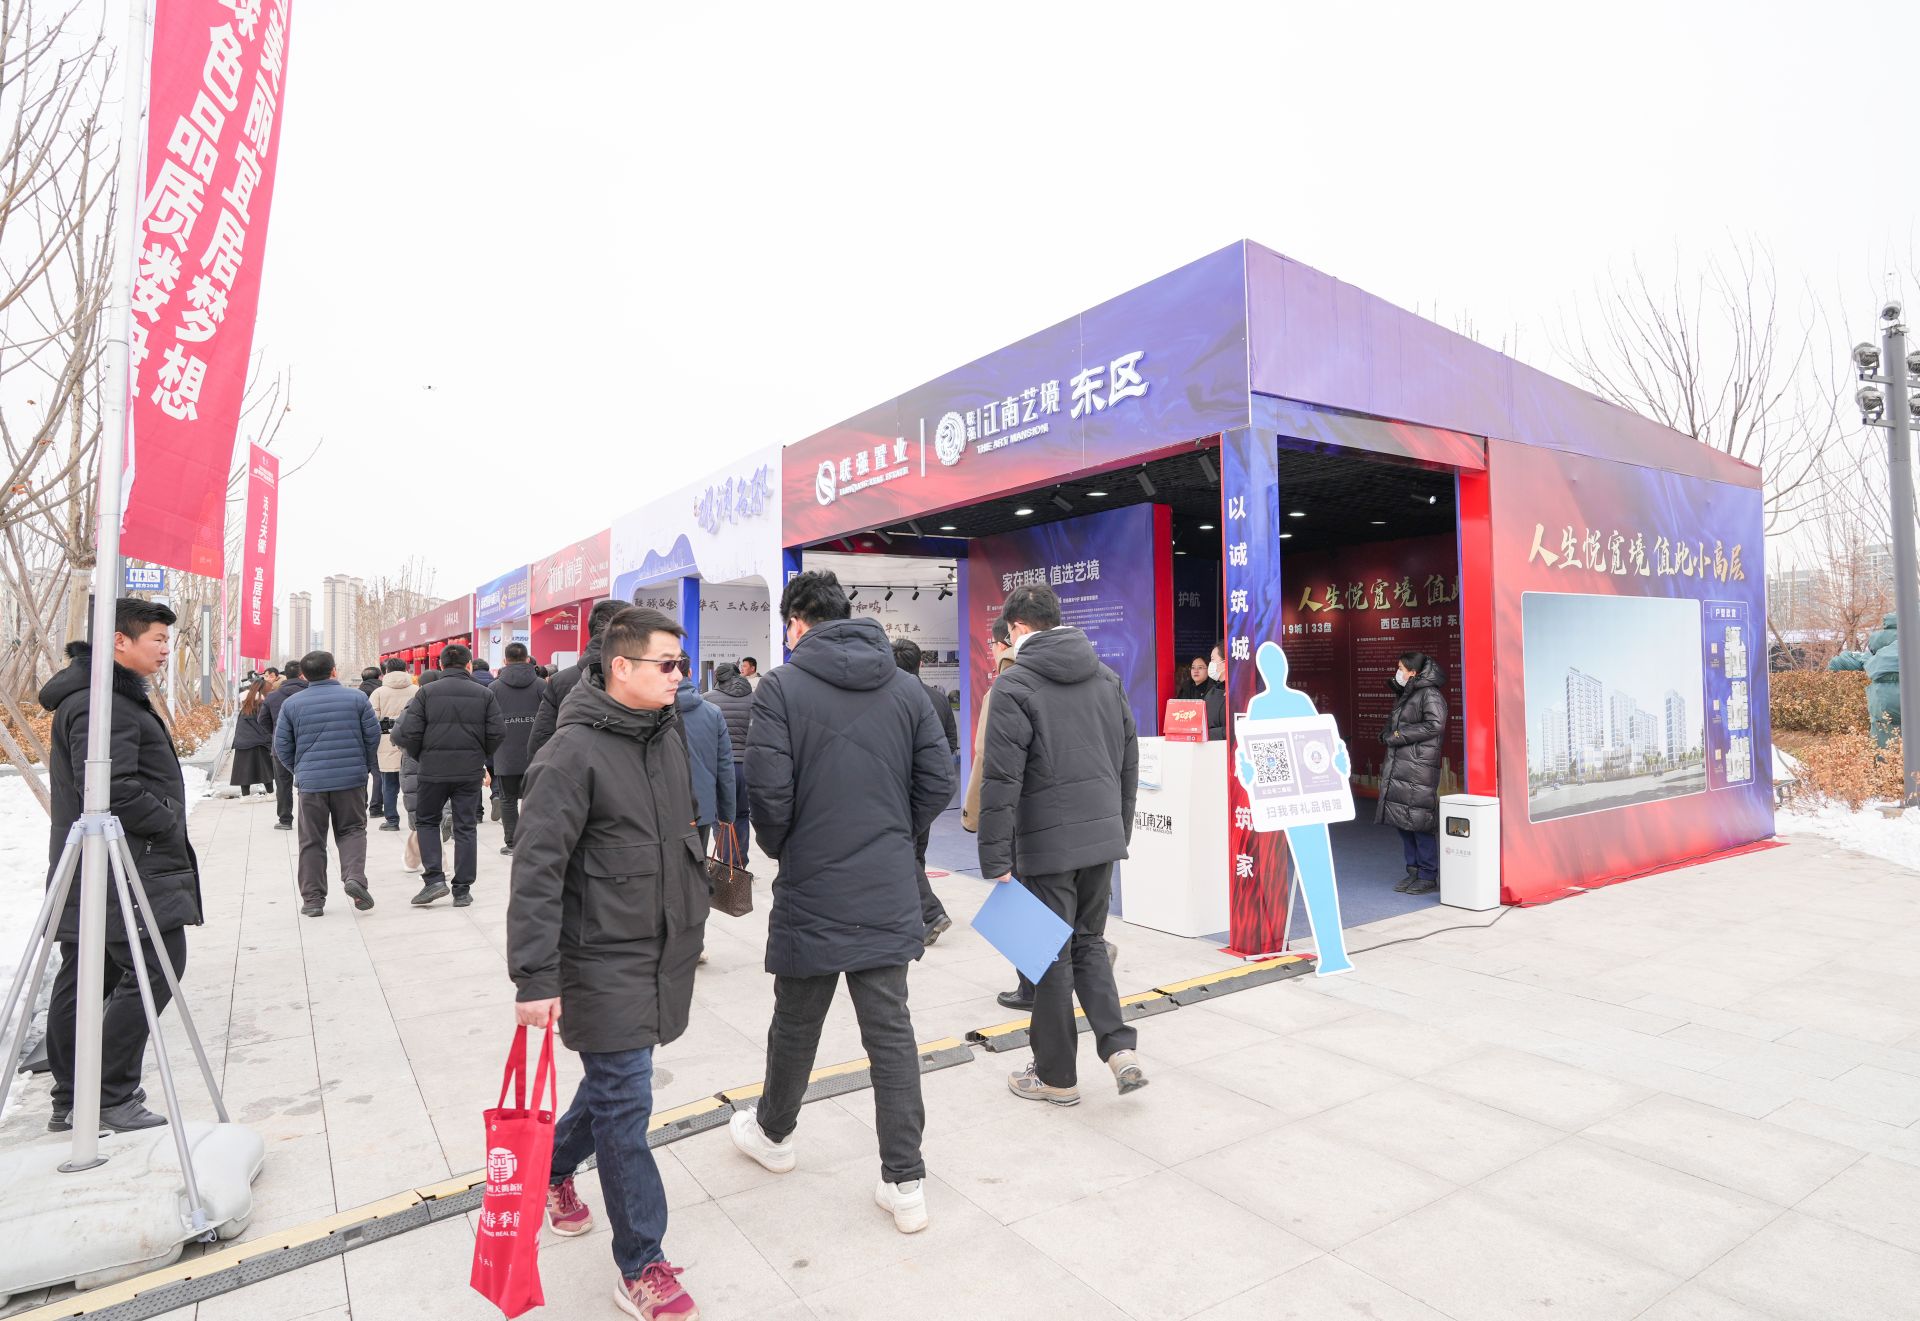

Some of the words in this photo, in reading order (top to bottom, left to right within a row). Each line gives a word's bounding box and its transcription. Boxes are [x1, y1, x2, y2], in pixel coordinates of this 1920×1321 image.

[151, 0, 288, 421] 美丽宜居梦想
[1069, 351, 1150, 419] 东区
[983, 380, 1061, 436] 江南艺境
[976, 442, 993, 454] THE
[993, 436, 1009, 449] ART
[1010, 423, 1050, 443] MANSION
[839, 437, 909, 482] 联强置业
[1527, 523, 1651, 577] 人生悦宽境
[1653, 536, 1746, 583] 值此小高层
[1002, 567, 1047, 592] 家在联强
[1049, 559, 1100, 587] 值选艺境
[1228, 496, 1250, 661] 以诚筑城
[1178, 591, 1201, 607] 护航
[1298, 577, 1418, 612] 人生悦宽境
[1380, 615, 1443, 630] 西区品质交付
[1140, 812, 1172, 831] 江南艺境
[1266, 798, 1343, 819] 扫我有礼品相赠
